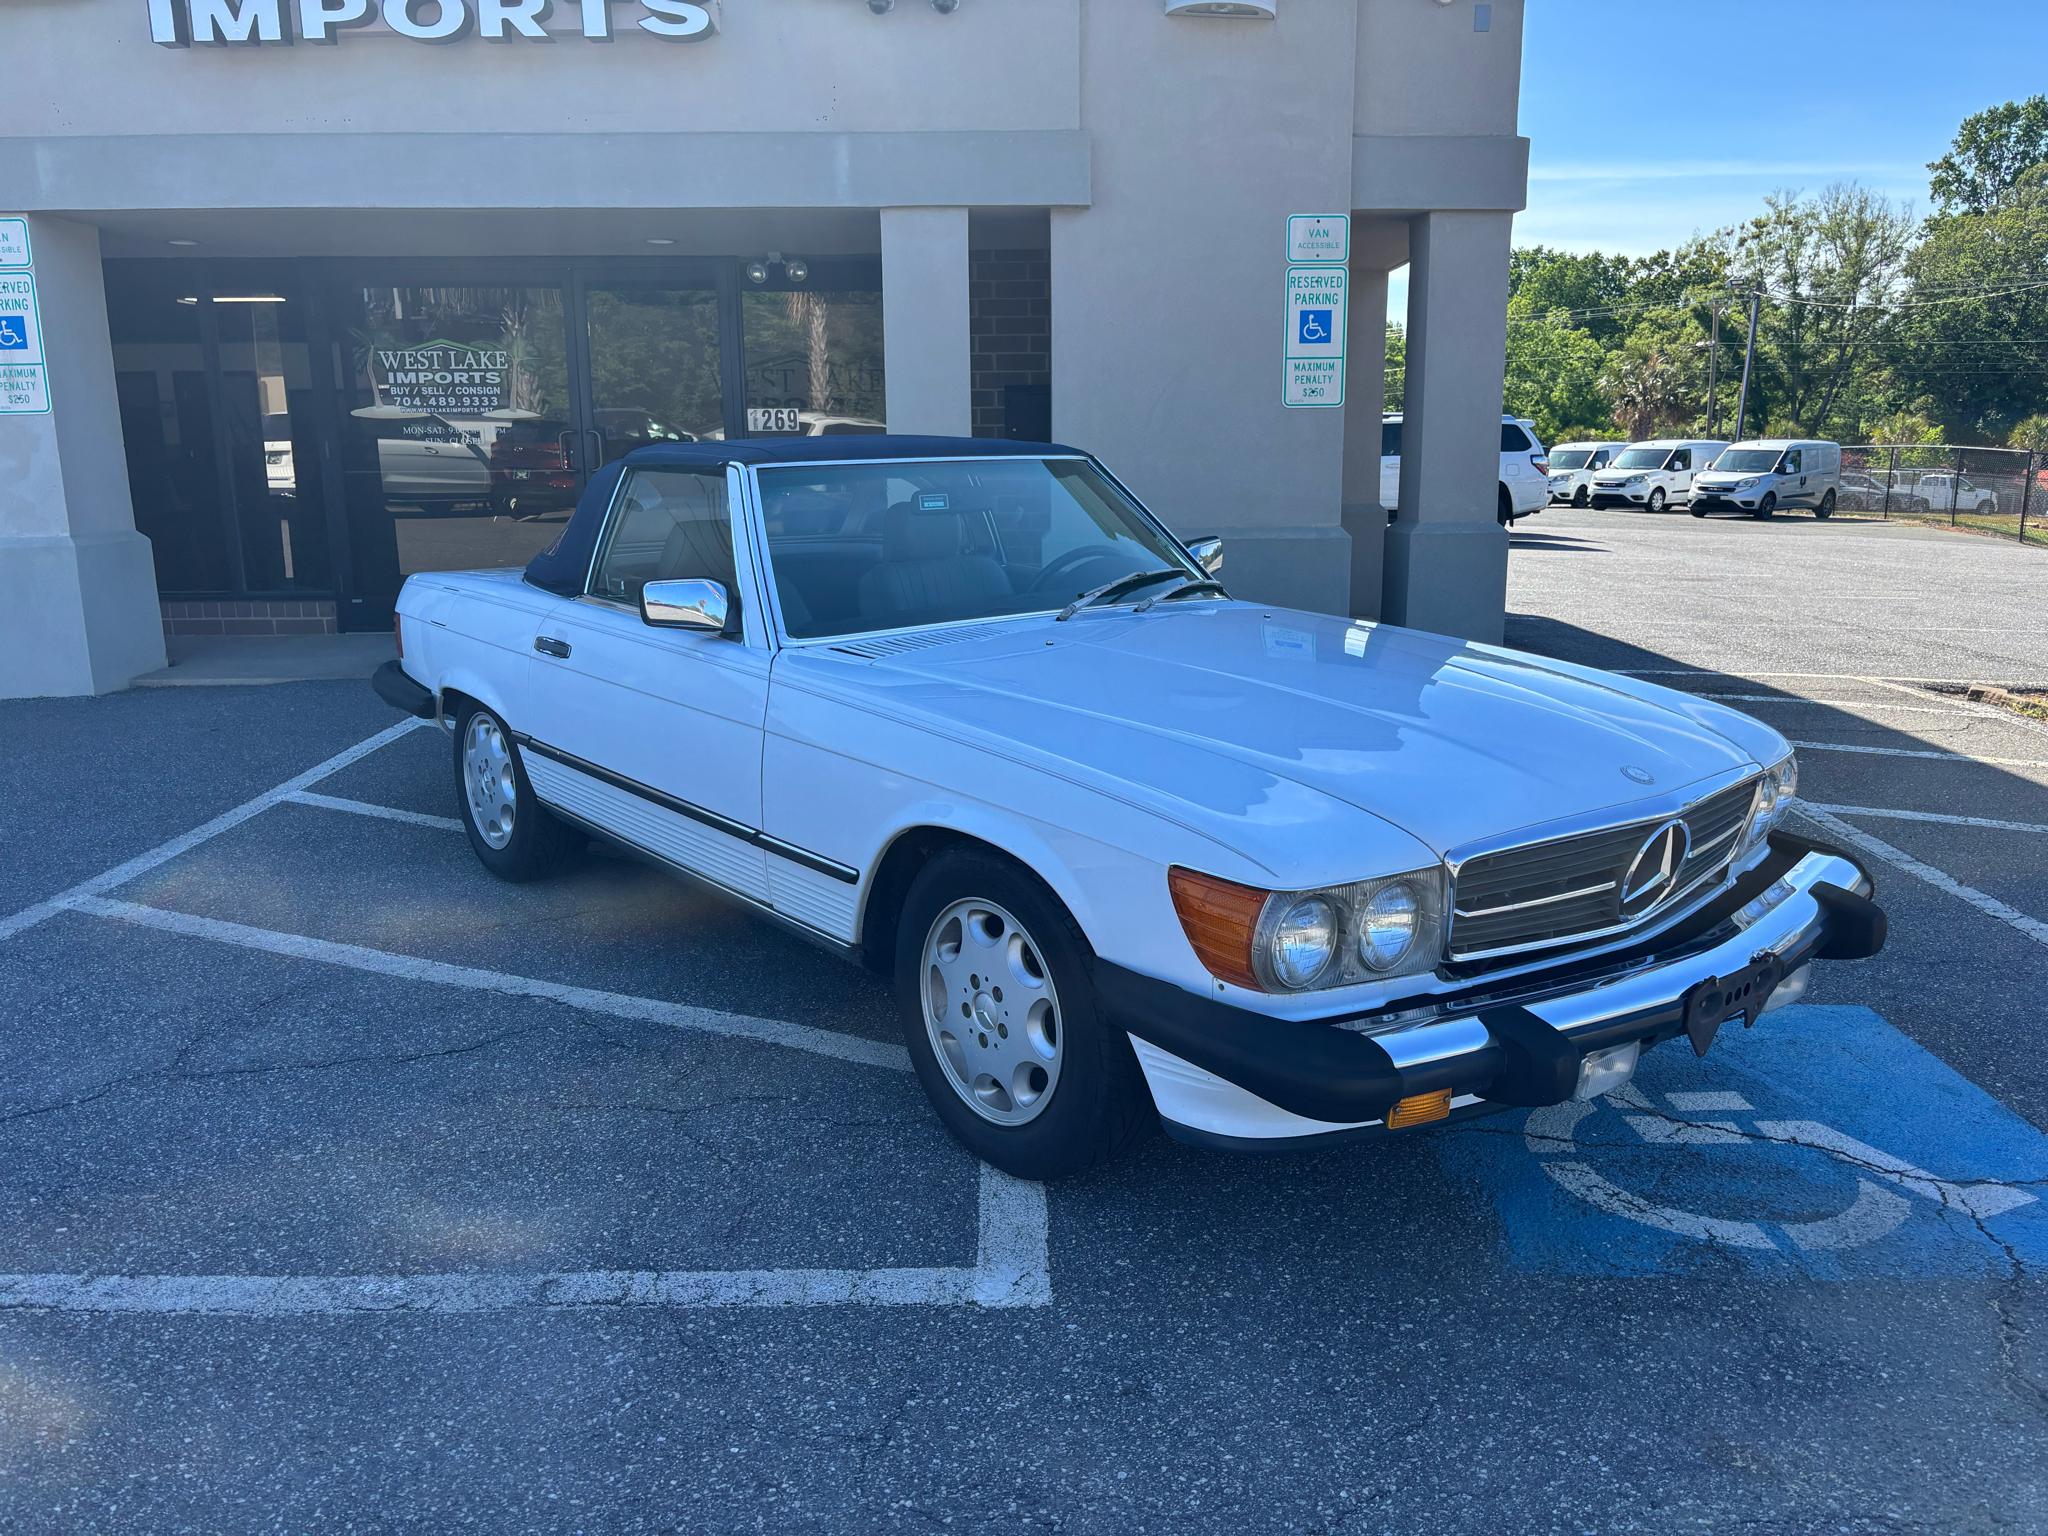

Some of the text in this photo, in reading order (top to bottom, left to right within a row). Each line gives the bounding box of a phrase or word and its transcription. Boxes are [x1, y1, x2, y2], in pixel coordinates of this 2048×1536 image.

[148, 0, 711, 44] IMPORTS
[1308, 229, 1329, 238] VAN
[0, 246, 21, 254] SIBLE
[1290, 276, 1343, 289] RESERVED
[1295, 293, 1338, 305] PARKING
[378, 351, 508, 369] WEST LAKE
[1294, 362, 1335, 371] MAXIMUM
[388, 371, 501, 384] IMPORTS
[1294, 375, 1333, 385] PENALTY
[390, 387, 409, 395] BUY
[421, 387, 445, 395] SELL
[455, 387, 500, 395] CONSIGN
[1302, 388, 1325, 397] $250
[8, 394, 30, 404] $250
[394, 397, 498, 406] 704.489.9333
[403, 426, 446, 435] MON-SAT:
